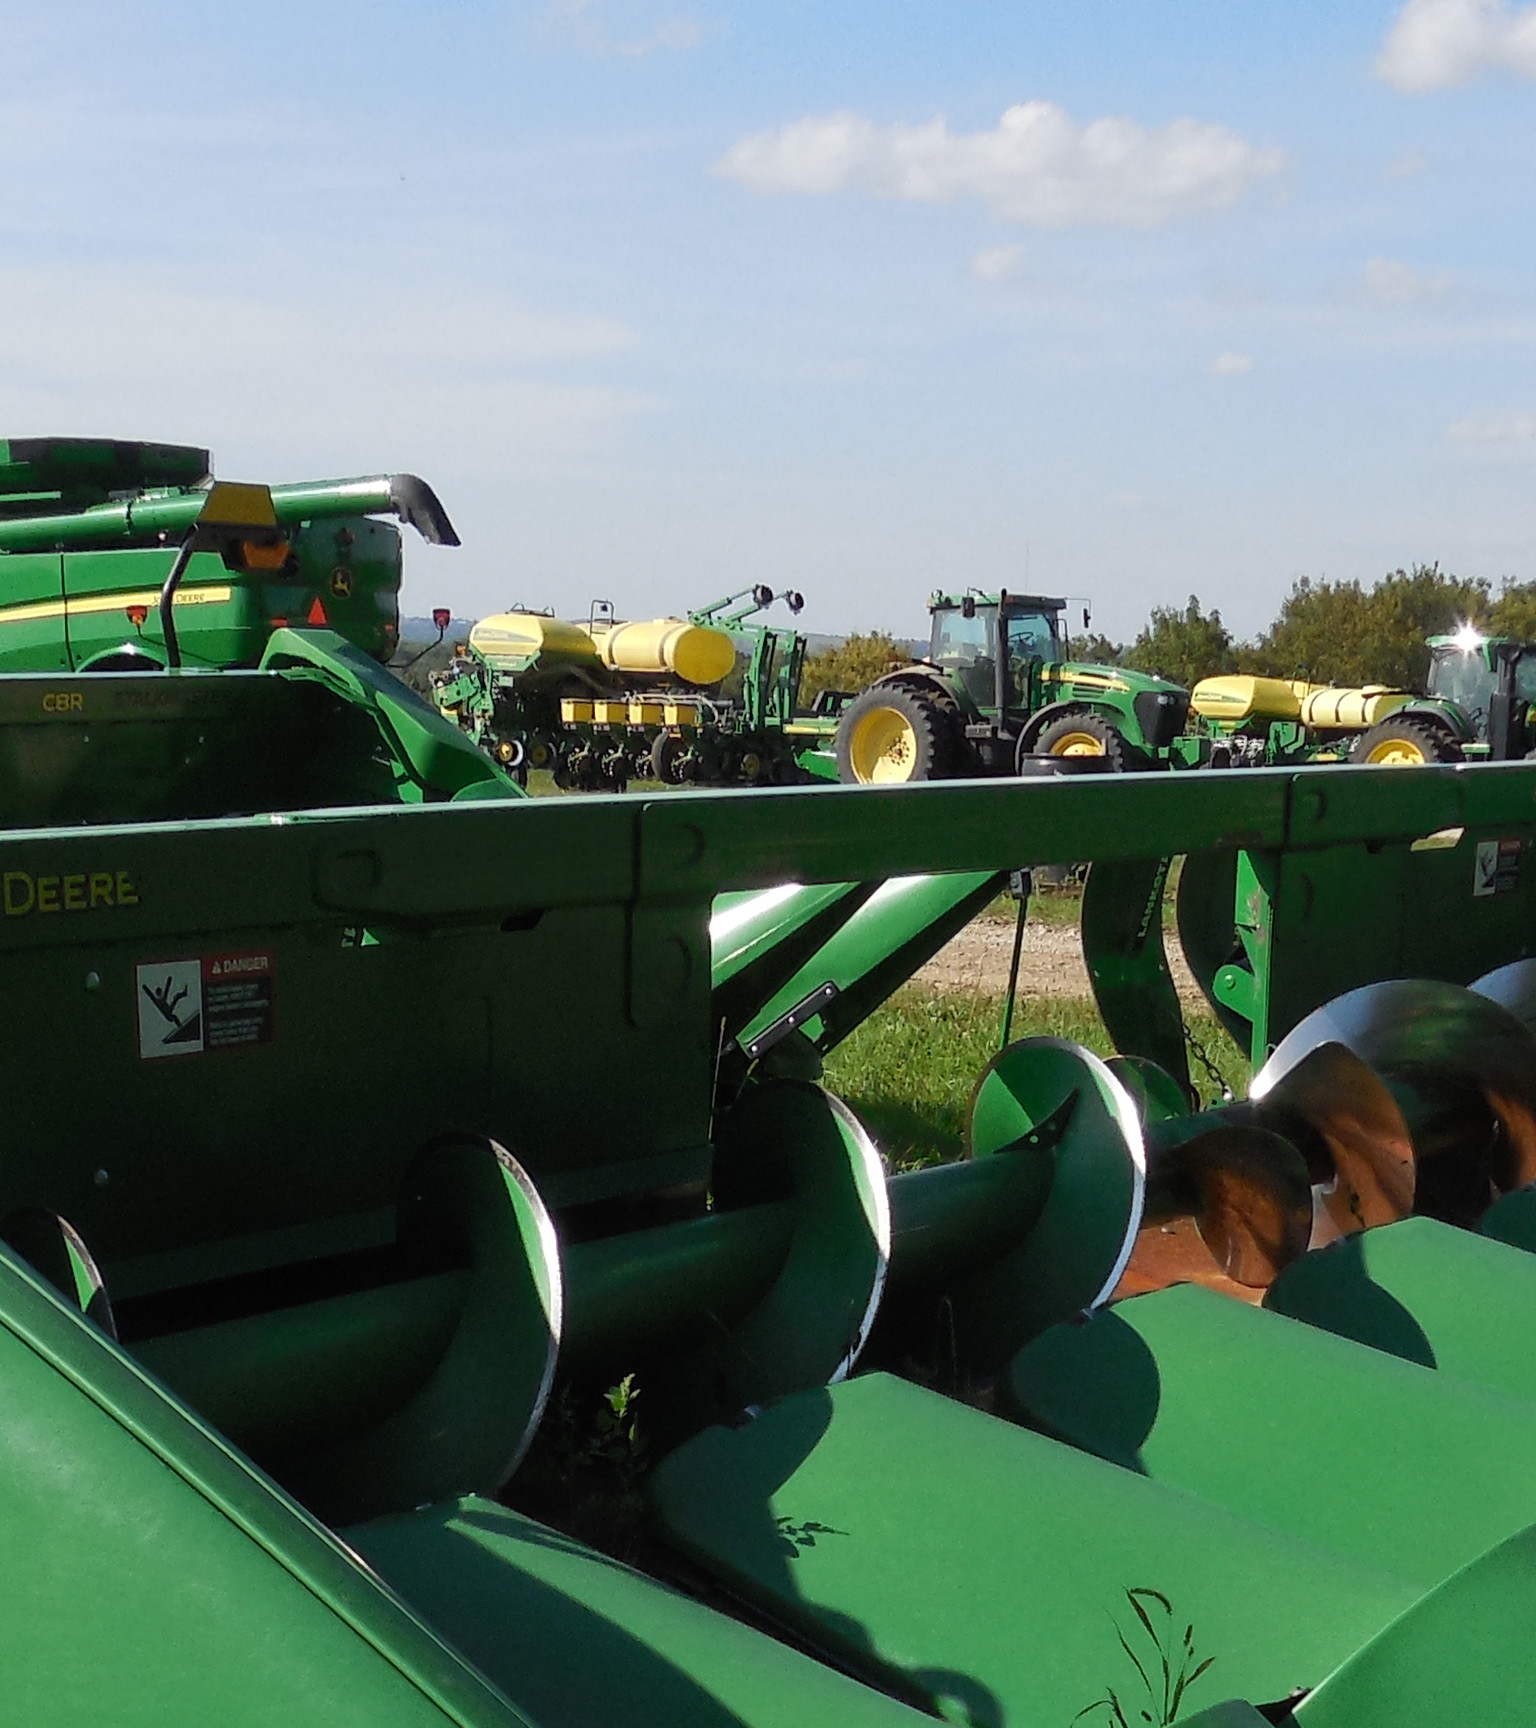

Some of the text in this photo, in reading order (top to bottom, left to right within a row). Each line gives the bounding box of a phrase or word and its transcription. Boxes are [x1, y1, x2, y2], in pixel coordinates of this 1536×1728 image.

[176, 593, 205, 603] DEERE
[41, 691, 84, 713] CBR
[2, 871, 140, 916] DEERE
[223, 956, 269, 974] DANGER
